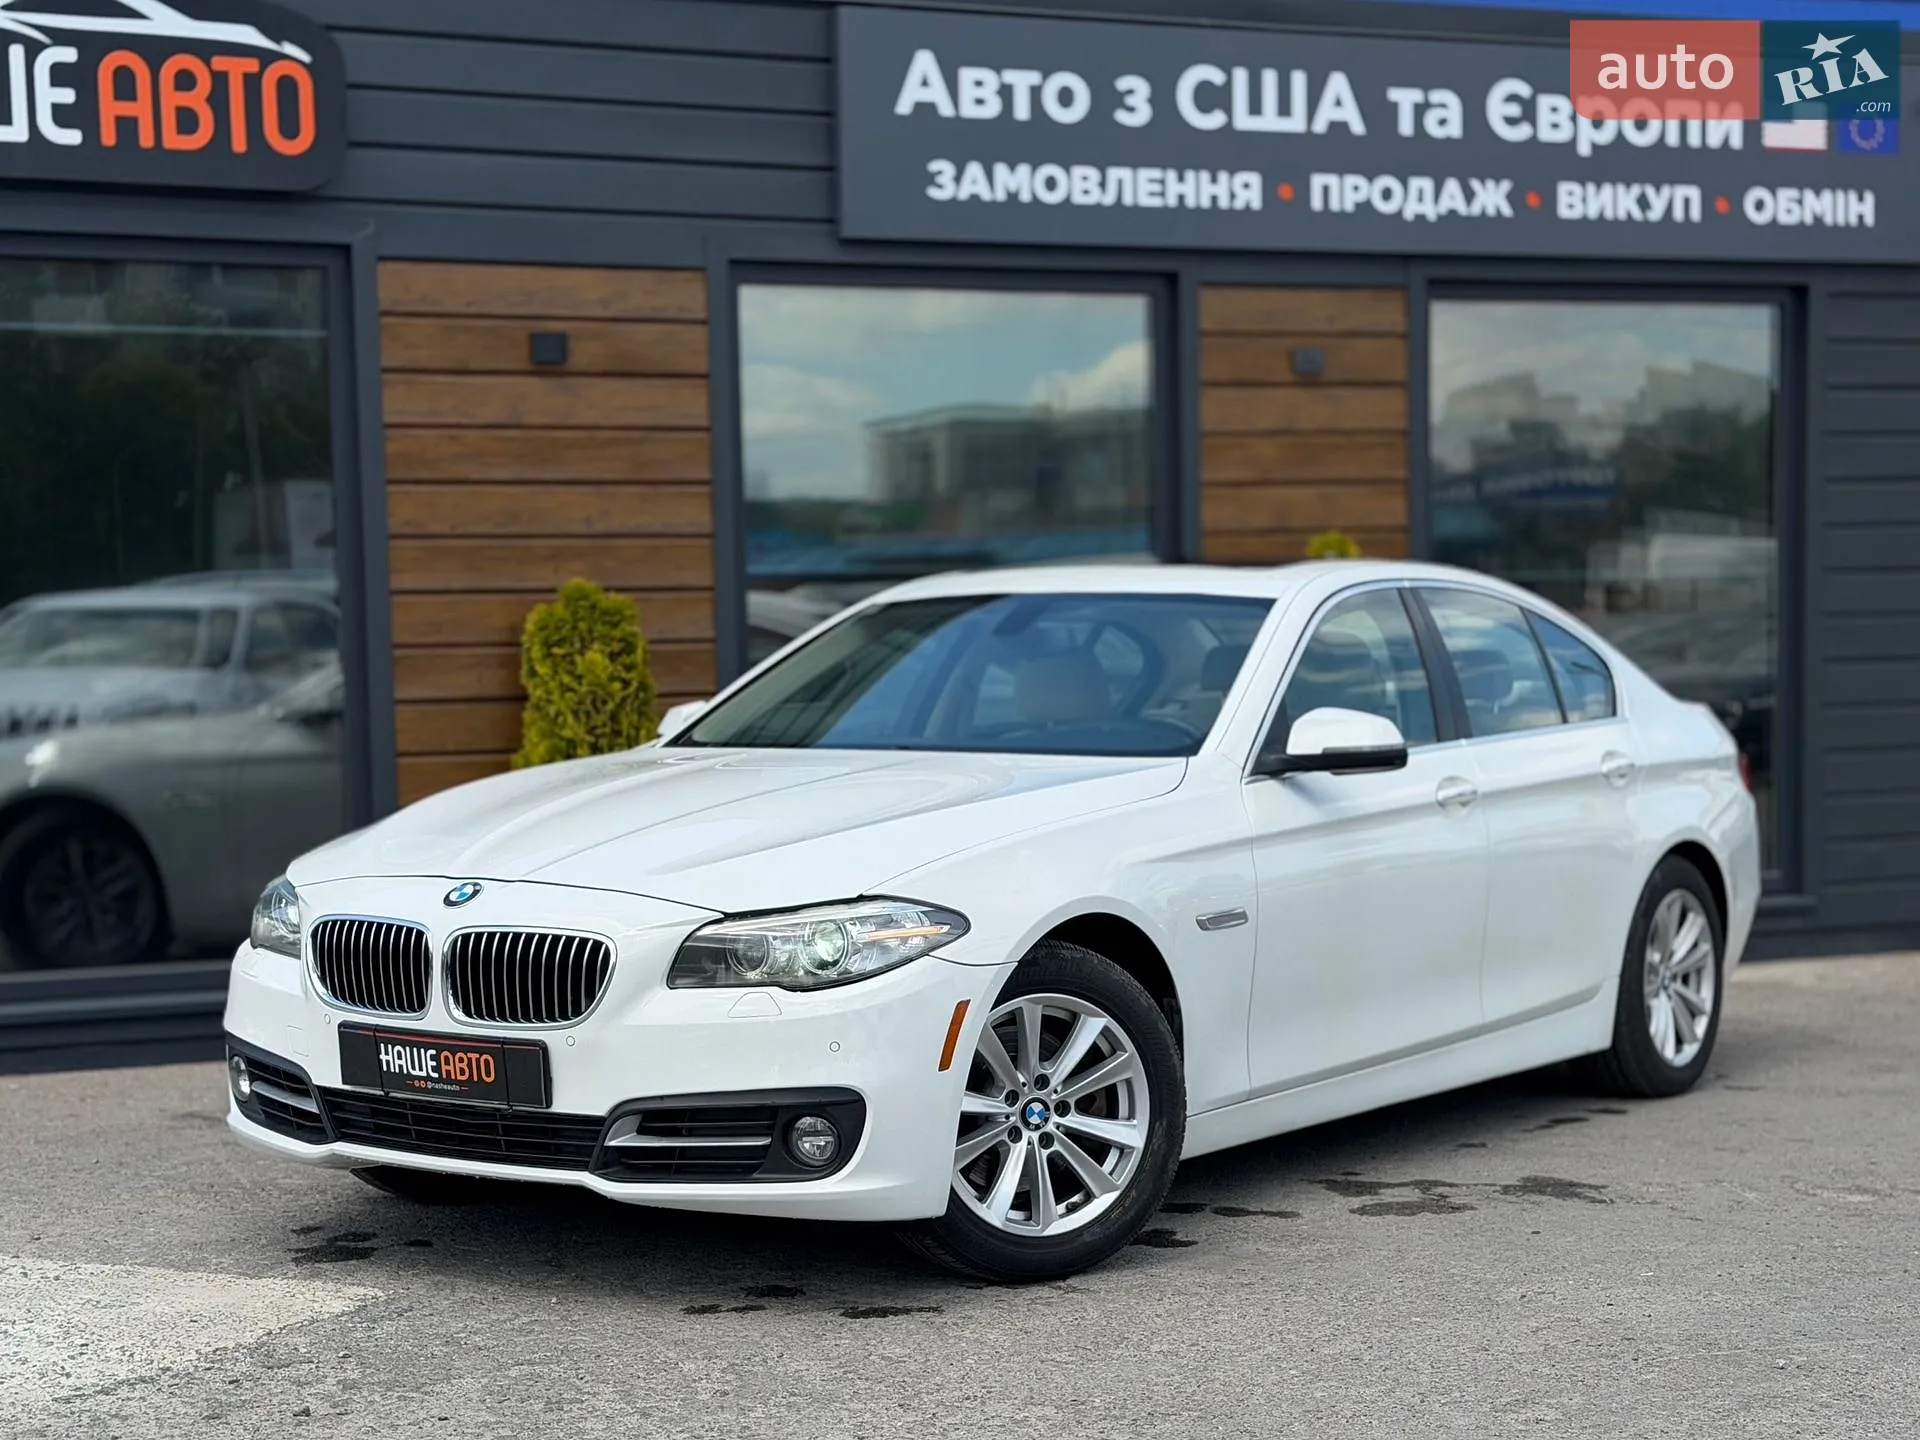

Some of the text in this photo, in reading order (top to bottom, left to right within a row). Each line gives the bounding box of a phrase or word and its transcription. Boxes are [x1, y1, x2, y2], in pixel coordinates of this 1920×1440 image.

[97, 49, 316, 156] АВТО
[894, 49, 1744, 157] Авто з США та Європи
[925, 158, 1876, 228] ЗАМОВЛЕННЯ ПРОДАЖ ВИКУП ОБМІН
[379, 1042, 495, 1083] НАШЕ АВТО
